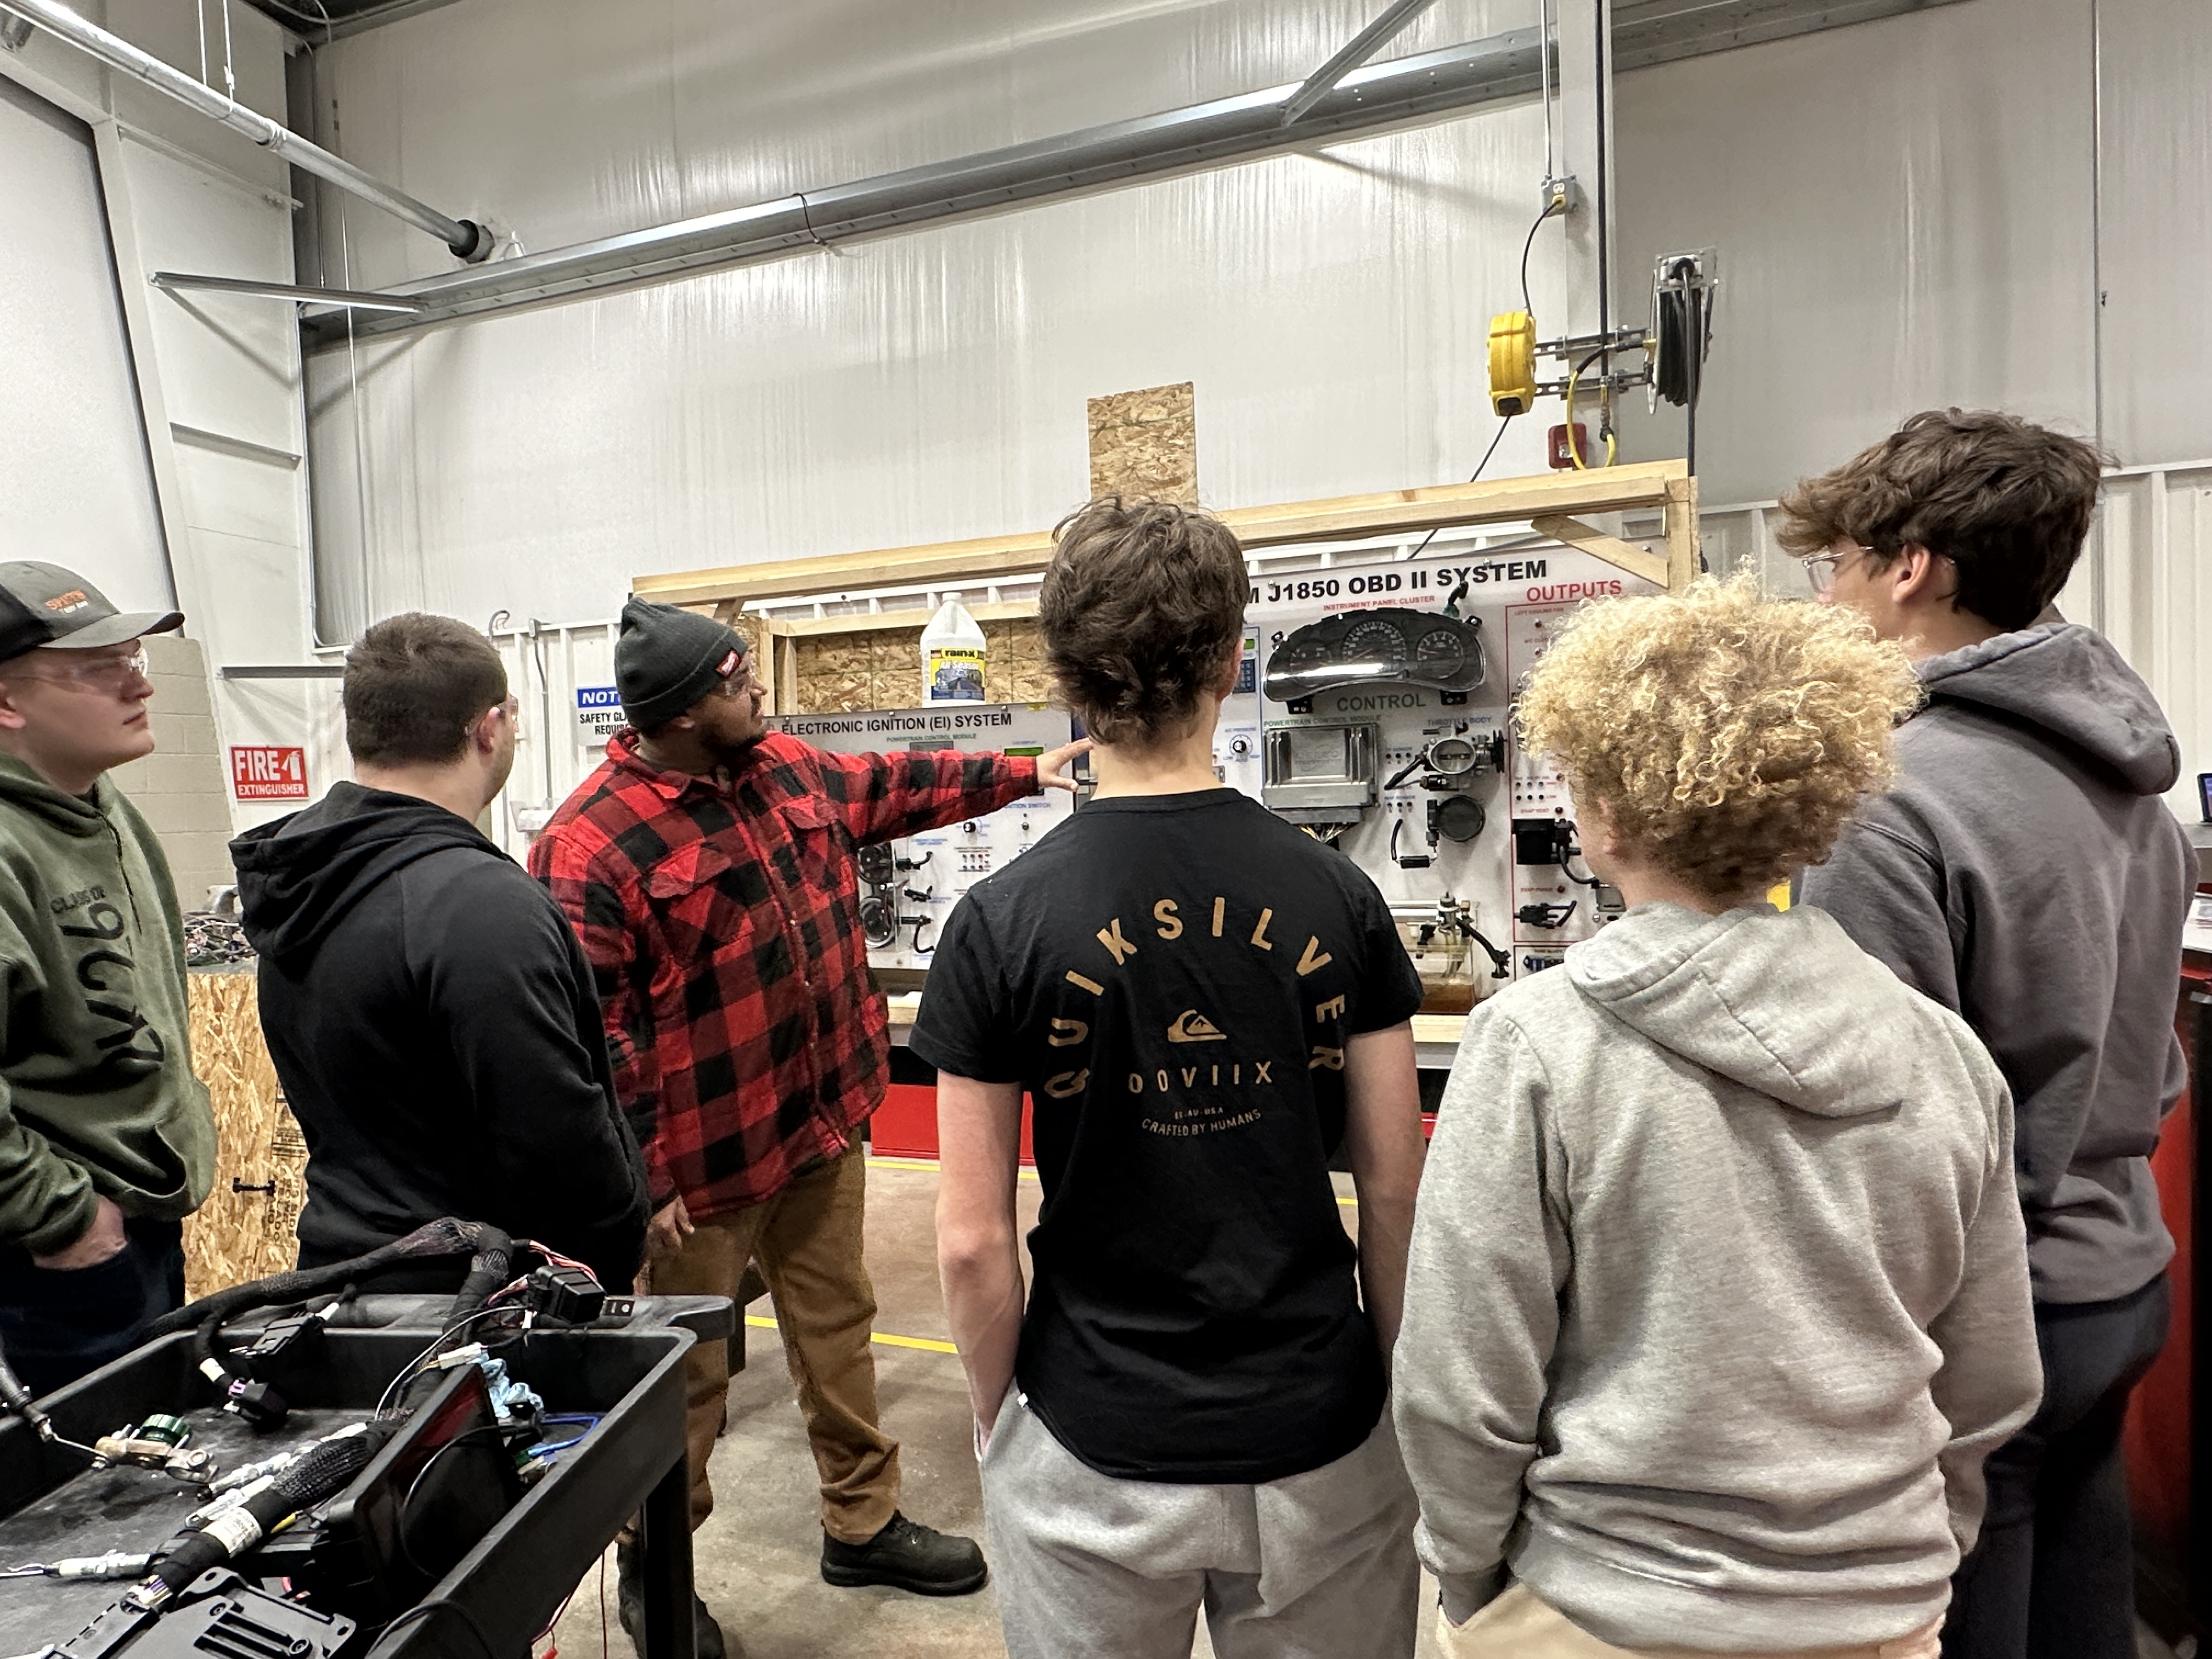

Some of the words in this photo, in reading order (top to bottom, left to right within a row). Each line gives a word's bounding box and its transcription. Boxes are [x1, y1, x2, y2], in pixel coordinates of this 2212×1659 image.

[1268, 579, 1340, 602] J1850
[1348, 574, 1401, 594] OBD
[1411, 572, 1426, 589] II
[1436, 560, 1547, 586] SYSTEM
[1526, 579, 1622, 602] OUTPUTS
[1323, 601, 1371, 611] INSTRUMENT
[1373, 599, 1399, 607] PANEL
[1400, 595, 1435, 605] CLUSTER
[1337, 693, 1426, 712] CONTROL
[579, 712, 611, 724] SAFETY
[781, 720, 863, 735] ELECTRONIC
[867, 717, 925, 732] IGNITION
[929, 716, 951, 731] (EI)
[955, 713, 1012, 727] SYSTEM
[1263, 718, 1311, 727] POWERTRAIN
[234, 751, 281, 781] FIRE
[238, 783, 305, 795] EXTINGUISHER
[1043, 896, 1345, 1098] QUIKSILVER
[1142, 1118, 1189, 1136] CRAFTED
[1192, 1123, 1206, 1135] BY
[1210, 1108, 1261, 1132] HUMANS
